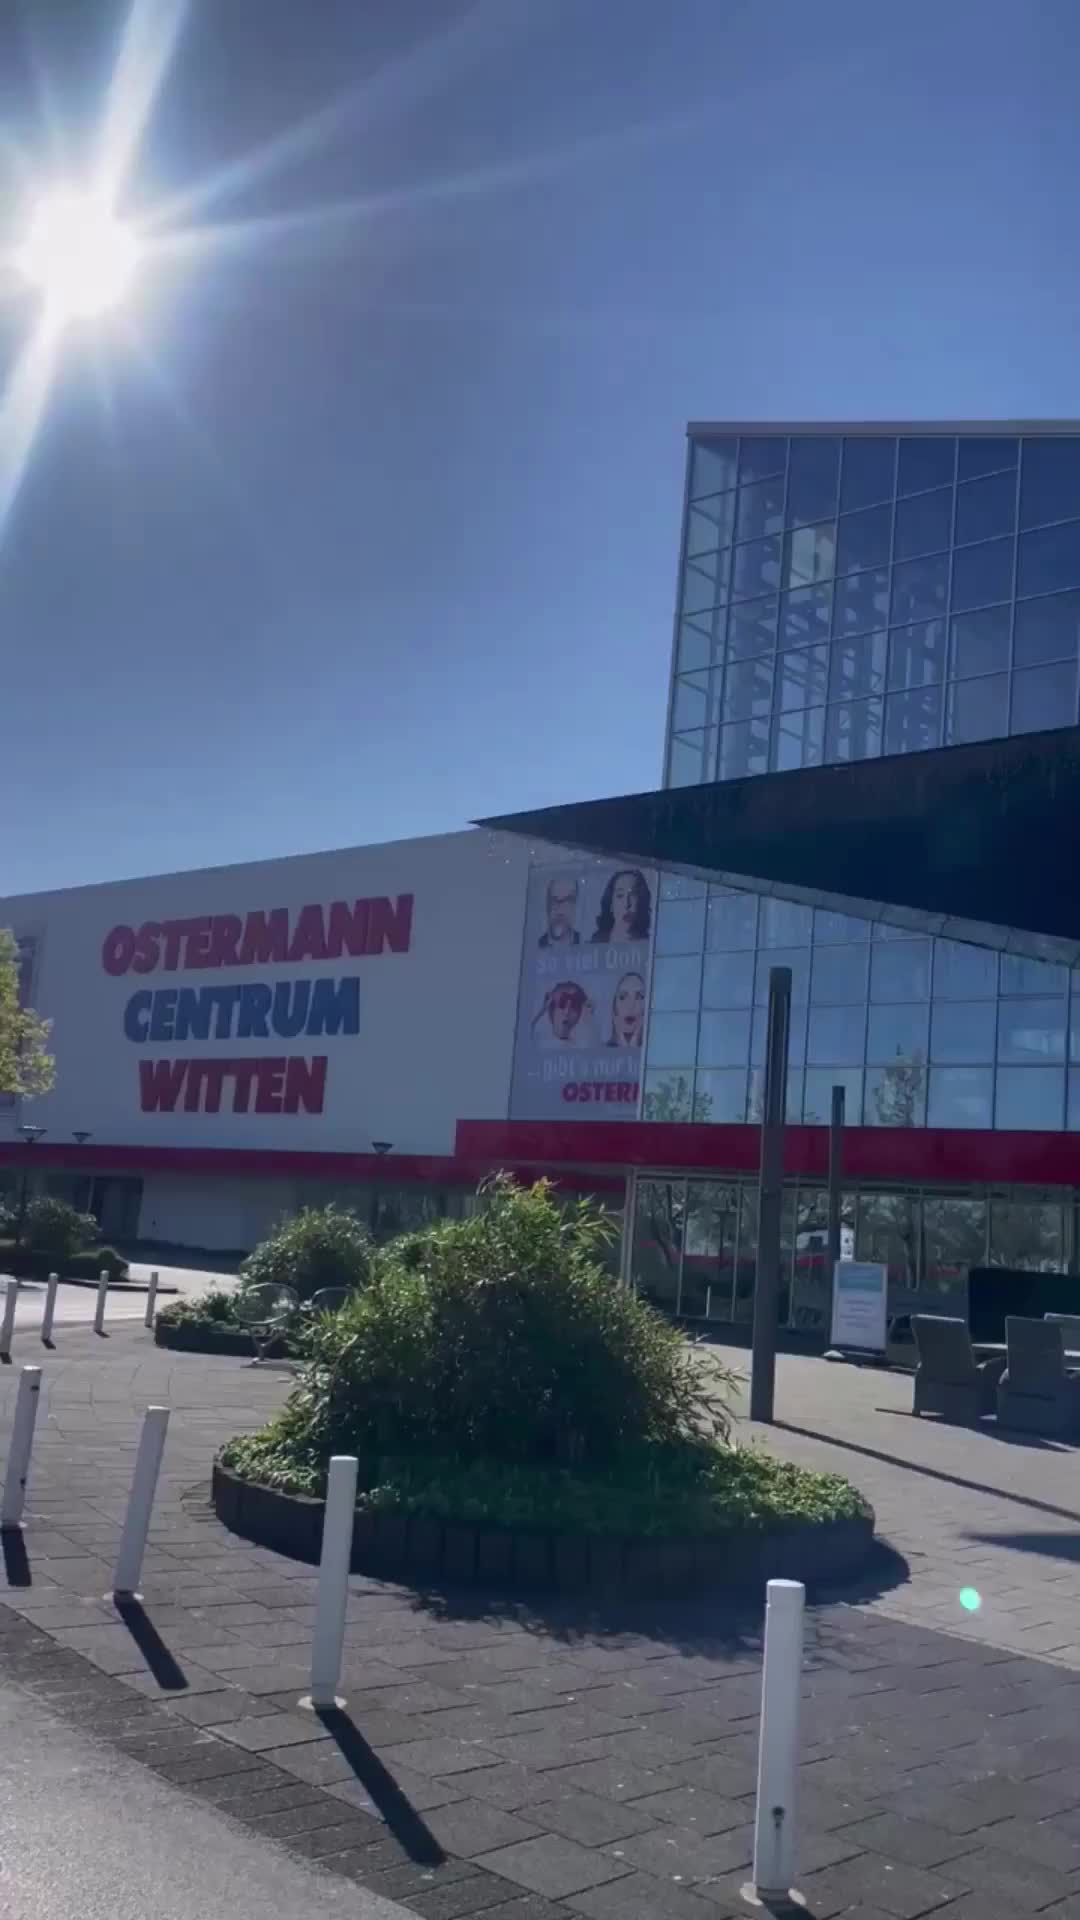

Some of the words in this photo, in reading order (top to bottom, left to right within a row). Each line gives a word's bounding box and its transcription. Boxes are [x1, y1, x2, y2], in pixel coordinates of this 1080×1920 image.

[103, 894, 414, 976] OSTERMANN
[124, 977, 360, 1043] CENTRUM
[139, 1056, 328, 1114] WITTEN
